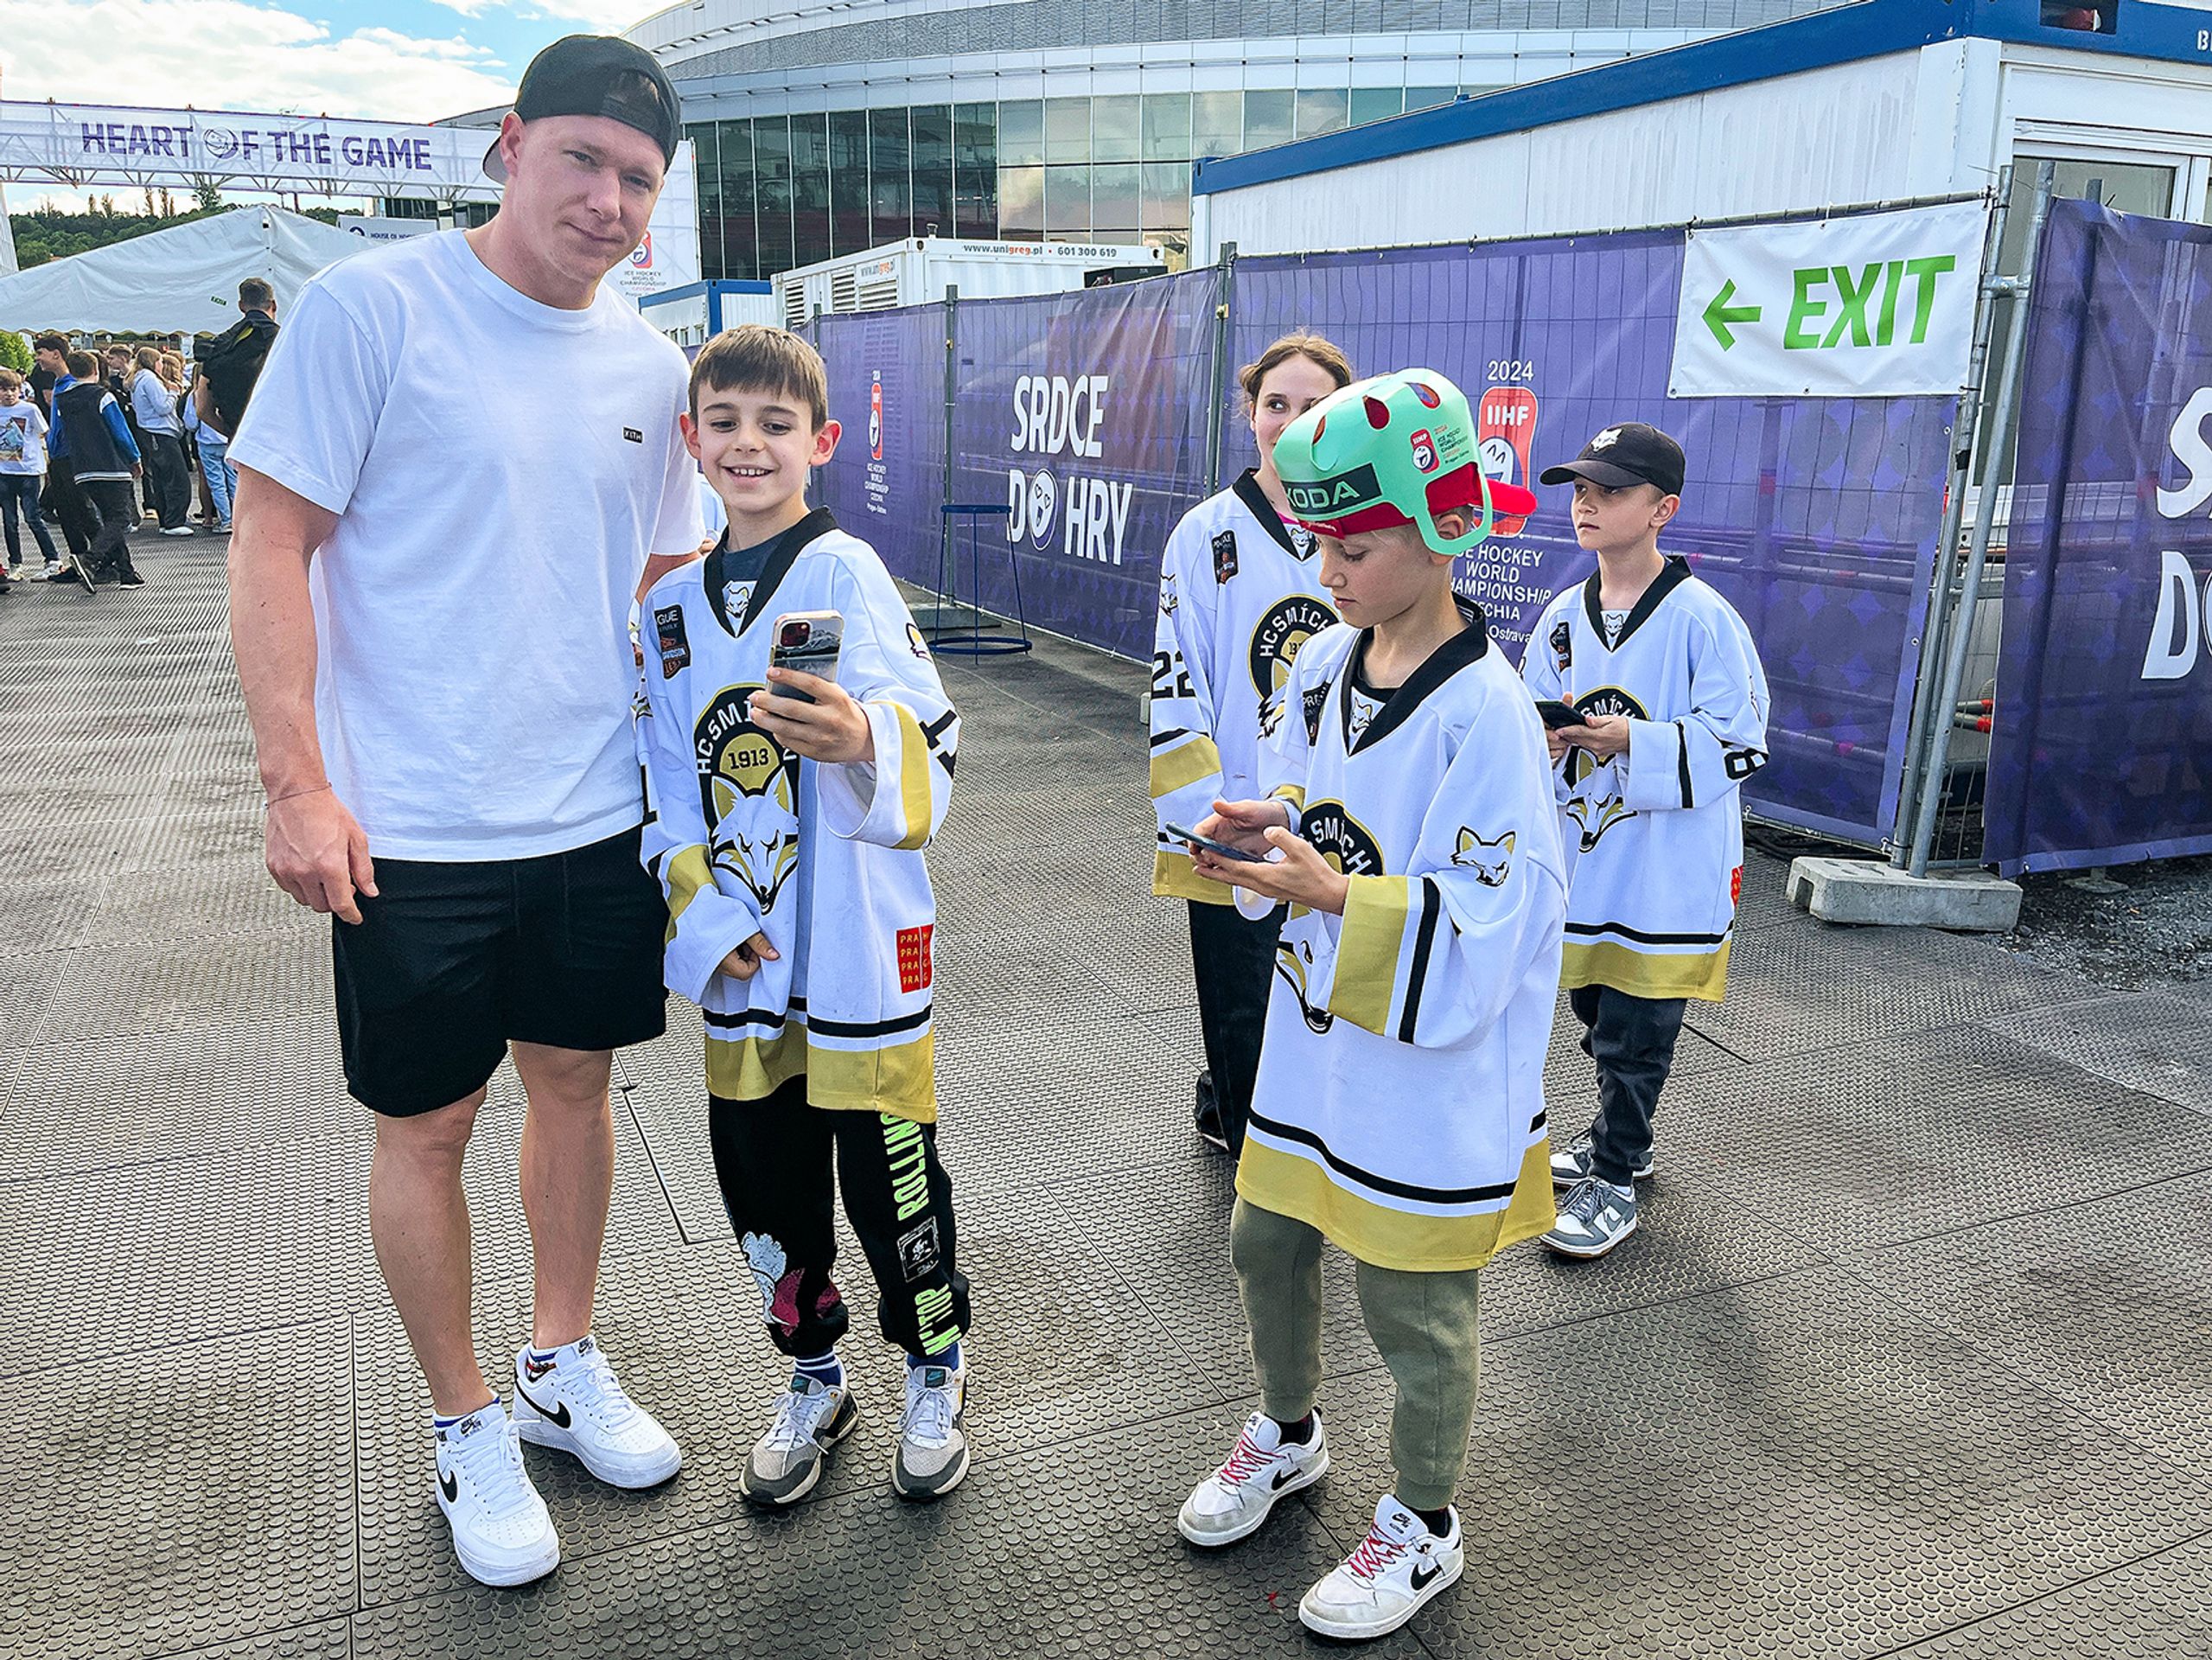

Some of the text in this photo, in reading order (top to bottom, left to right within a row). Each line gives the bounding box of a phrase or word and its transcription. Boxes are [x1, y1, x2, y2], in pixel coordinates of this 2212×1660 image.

[81, 122, 194, 157] HEART
[266, 131, 332, 164] THE
[341, 135, 433, 170] GAME
[964, 244, 1118, 259] www.unigreg.pl 601 300 619
[1783, 254, 1956, 350] EXIT
[1488, 360, 1534, 381] 2024
[1010, 374, 1109, 458] SRDCE
[1487, 404, 1529, 426] IIHF
[1064, 476, 1133, 566] HRY
[1478, 544, 1543, 567] HOCKEY
[1466, 561, 1520, 583] WORLD
[1488, 624, 1532, 643] Ostrava
[1151, 650, 1196, 699] 22
[728, 747, 768, 770] 1913
